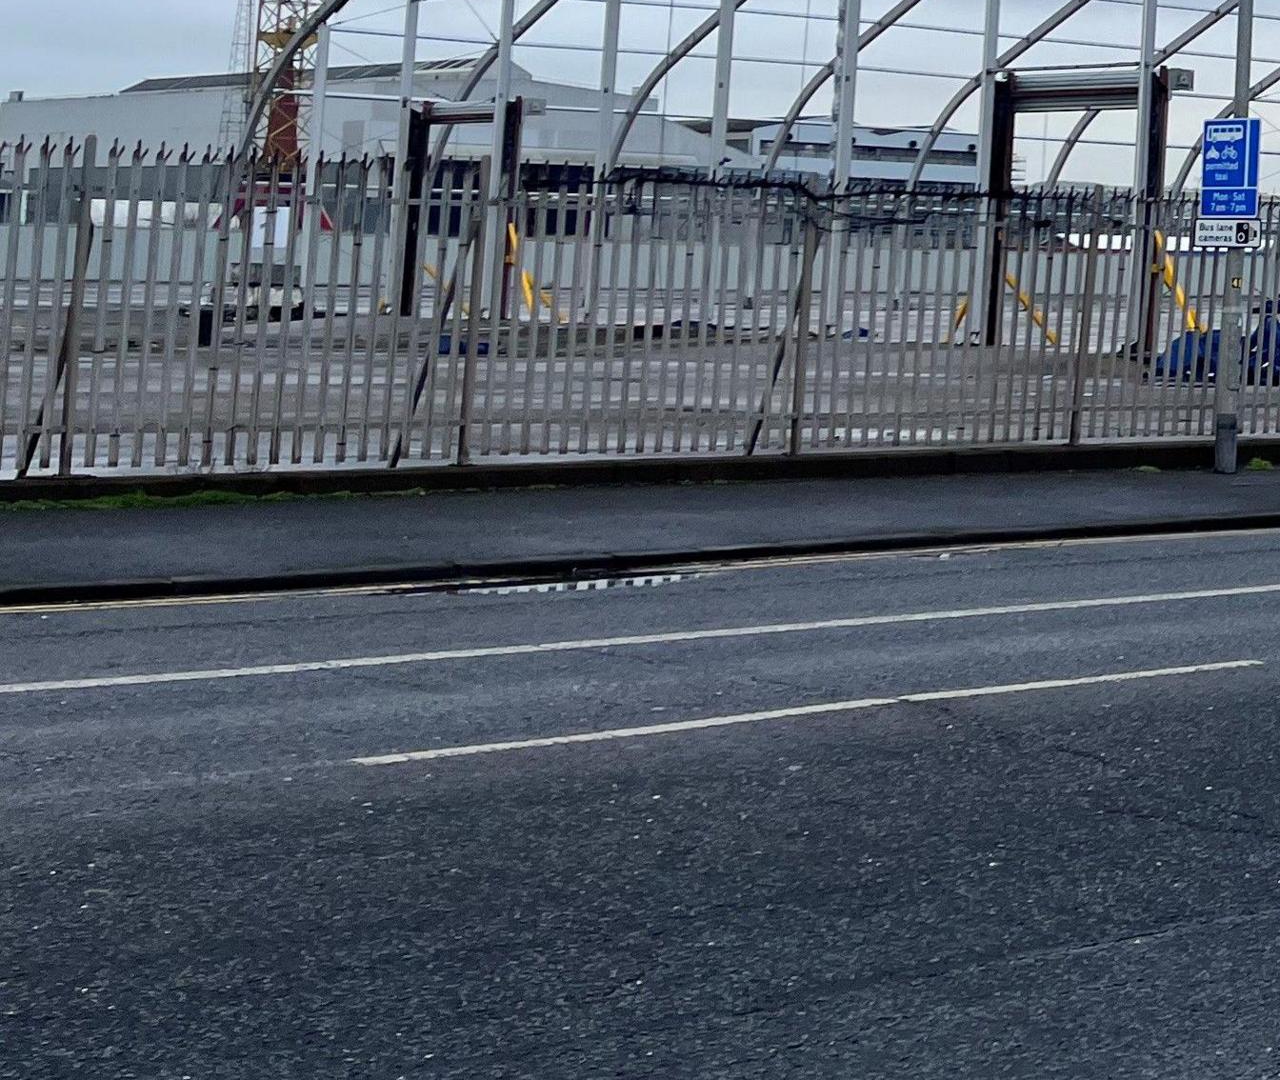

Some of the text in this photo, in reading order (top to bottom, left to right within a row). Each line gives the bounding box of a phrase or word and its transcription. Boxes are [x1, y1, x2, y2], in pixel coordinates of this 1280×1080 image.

[1199, 222, 1234, 232] Bus lane
[1199, 235, 1232, 243] cameras
